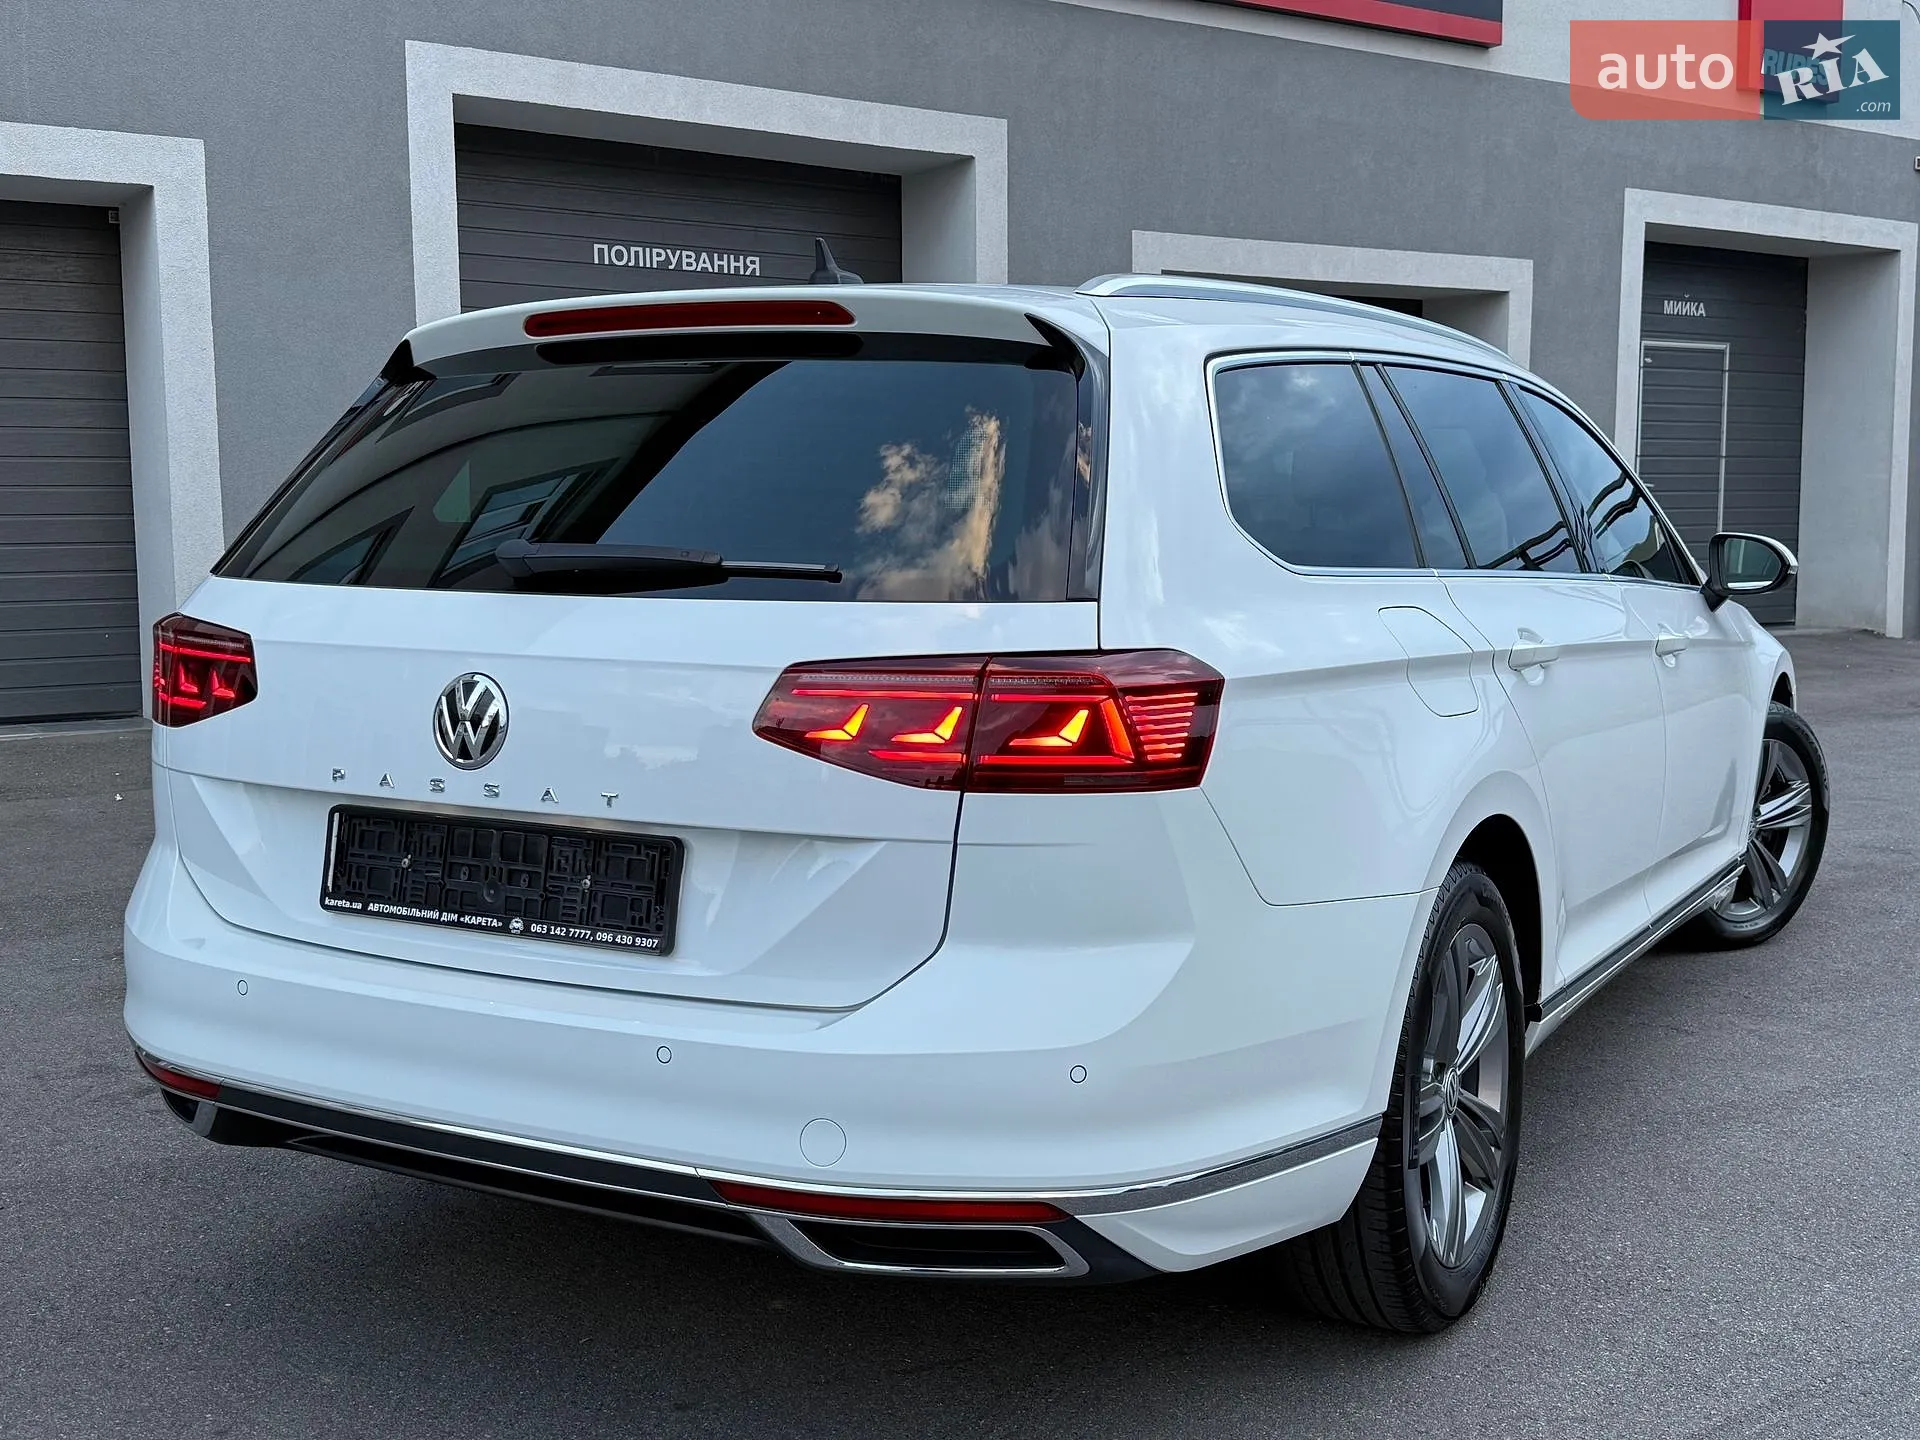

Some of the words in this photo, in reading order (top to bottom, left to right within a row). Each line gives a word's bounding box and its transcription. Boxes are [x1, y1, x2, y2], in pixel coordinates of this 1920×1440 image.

[593, 243, 760, 276] ПОЛІРУВАННЯ
[1663, 294, 1706, 317] МИЙКА
[331, 767, 619, 808] PASSAT
[324, 897, 362, 910] kareta.ua
[367, 903, 439, 920] АВТОМОБІЛЬНИЙ
[440, 913, 458, 923] ДІМ
[459, 915, 503, 928] «КАРЕТА»
[530, 923, 548, 934] 063
[550, 926, 566, 936] 142
[568, 928, 594, 941] 7777,
[596, 932, 613, 942] 096
[615, 934, 633, 945] 430
[635, 937, 659, 949] 9307
